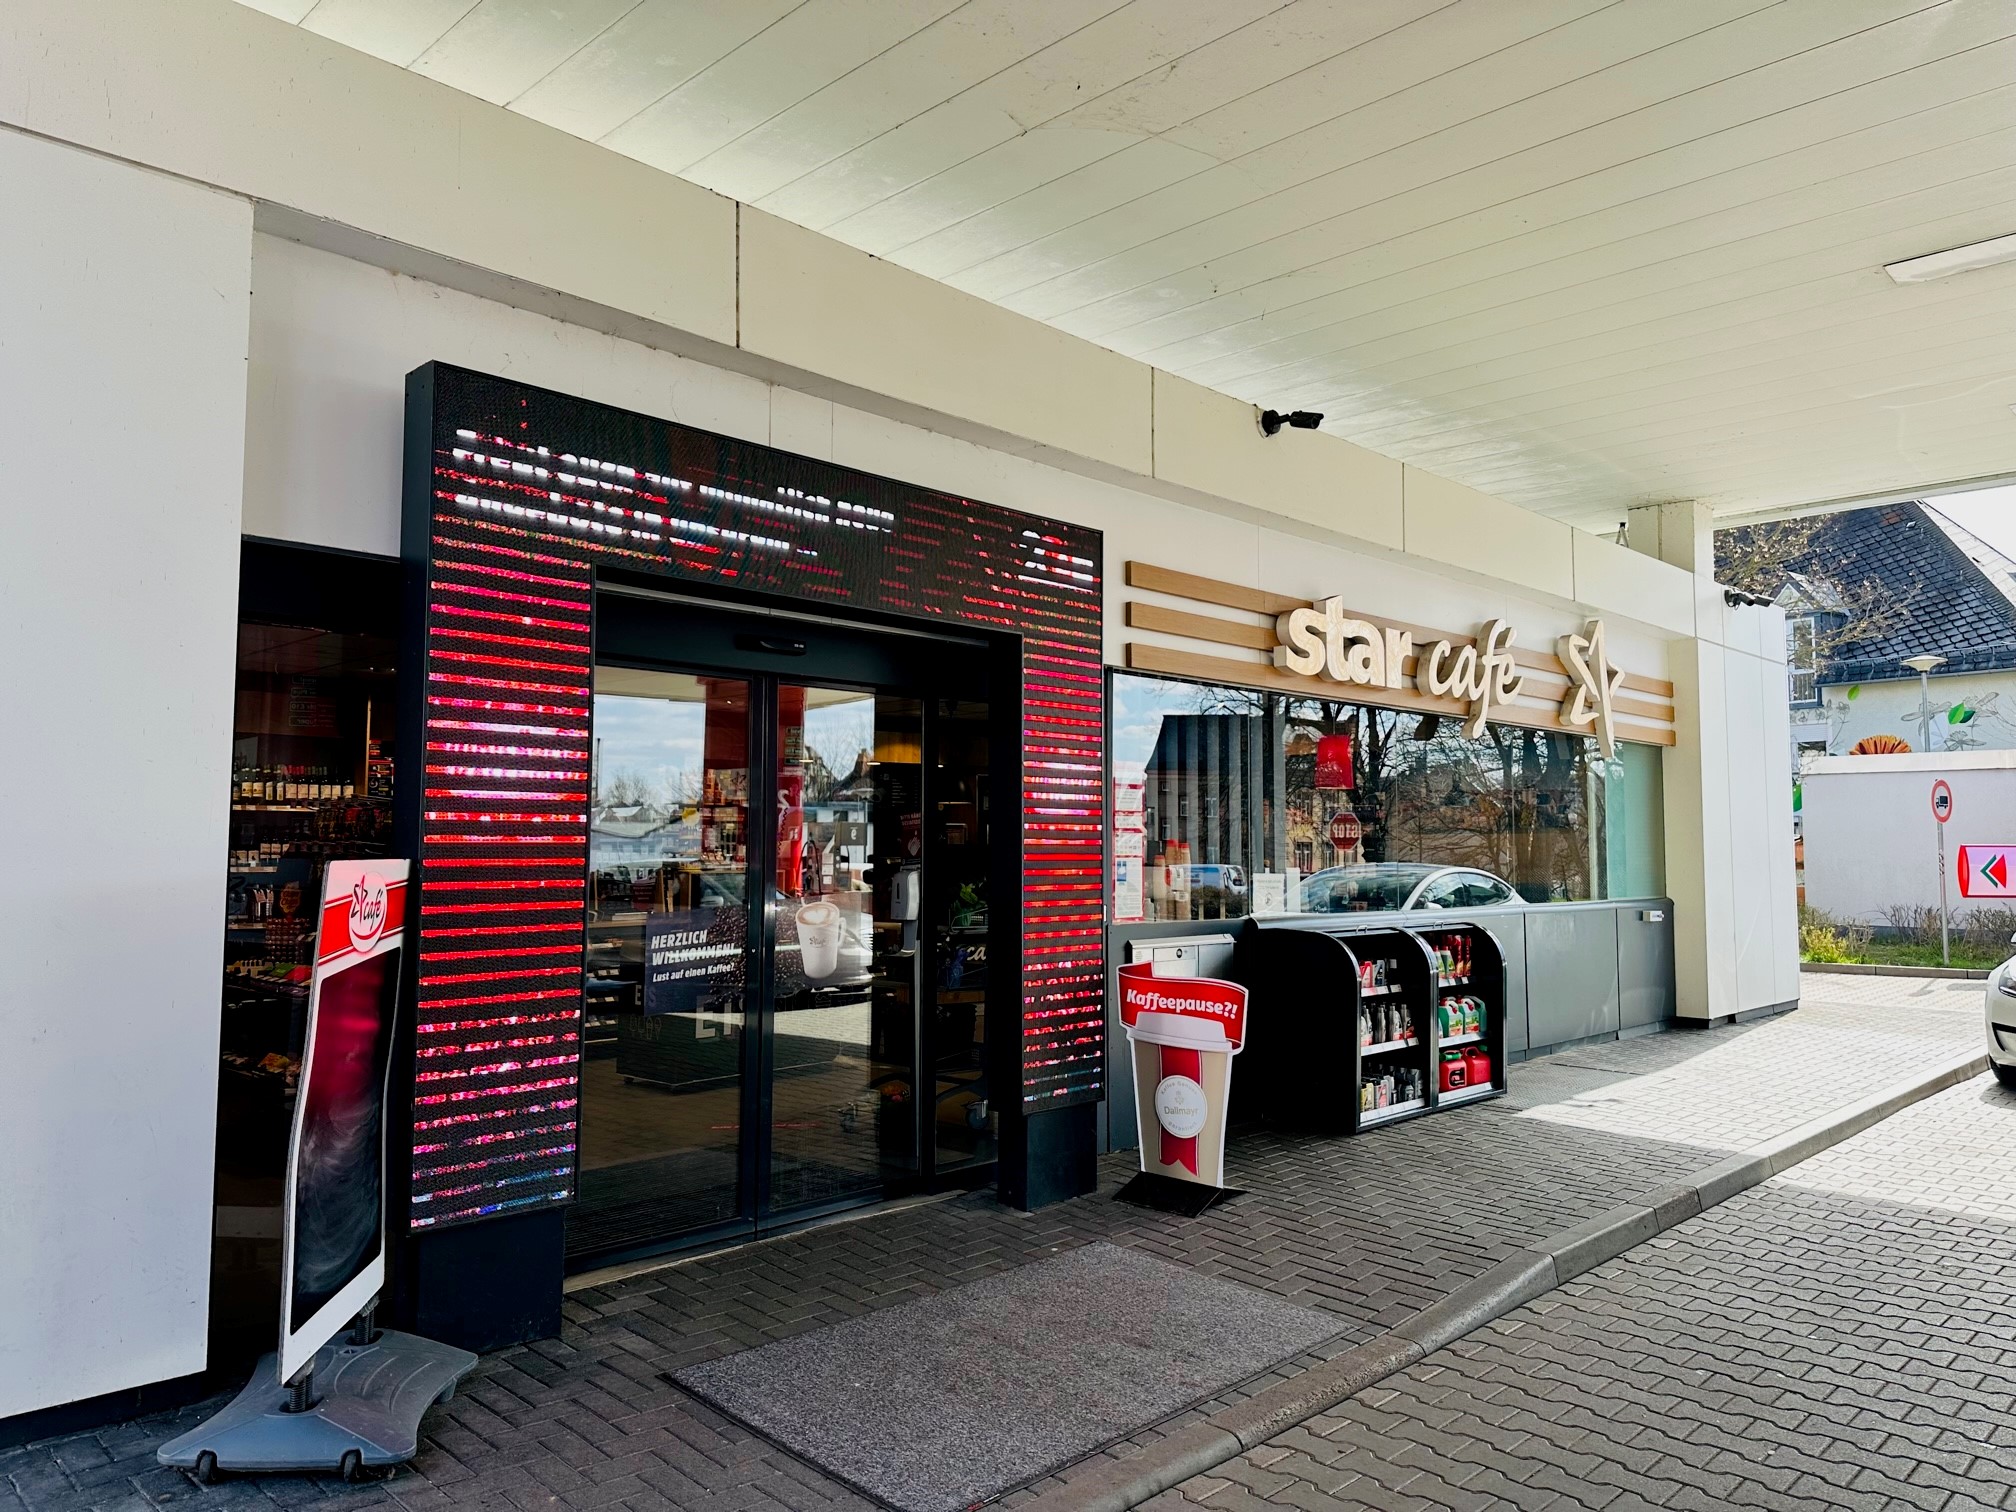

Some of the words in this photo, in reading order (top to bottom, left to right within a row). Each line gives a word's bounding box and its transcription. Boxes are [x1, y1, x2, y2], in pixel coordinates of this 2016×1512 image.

[1274, 595, 1412, 690] star
[1418, 618, 1523, 739] café
[363, 888, 383, 931] café
[651, 929, 708, 949] HERZLICH
[652, 943, 735, 965] WILLKOMMEN!
[652, 972, 669, 983] Lust
[670, 969, 684, 979] auf
[685, 967, 706, 978] einen
[707, 963, 735, 975] Kaffee?
[1127, 989, 1238, 1019] Kaffeepause?!
[1164, 1106, 1199, 1117] Dallmayr
